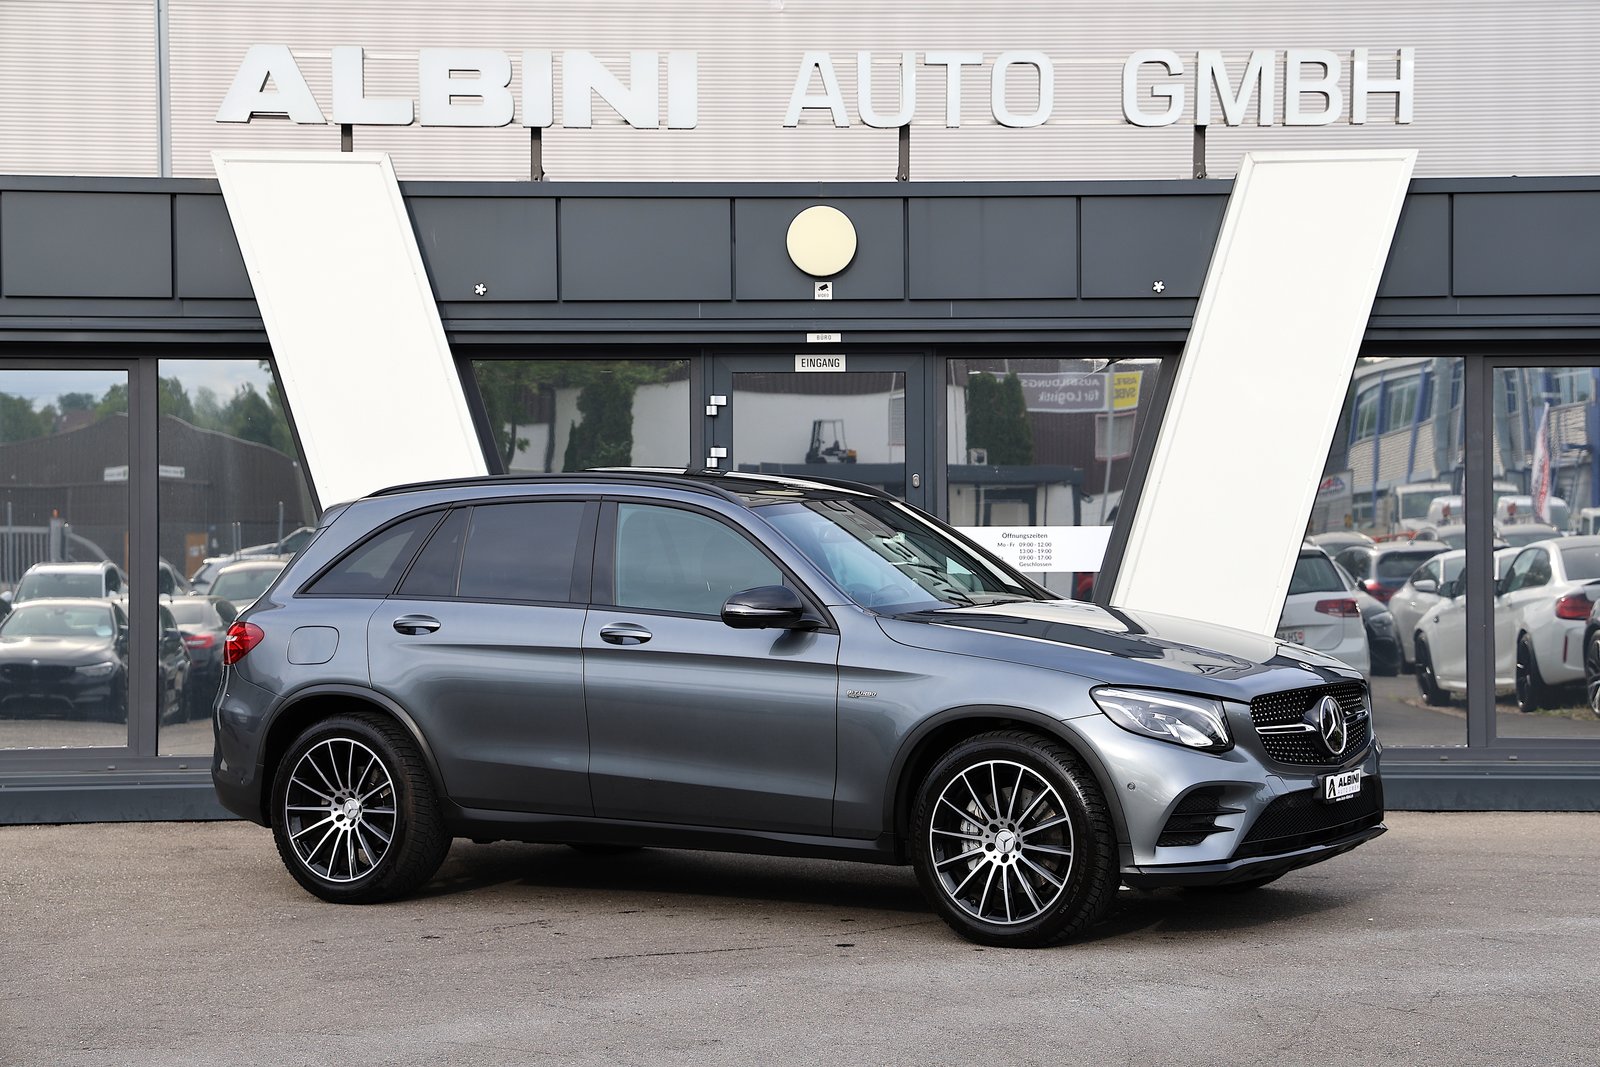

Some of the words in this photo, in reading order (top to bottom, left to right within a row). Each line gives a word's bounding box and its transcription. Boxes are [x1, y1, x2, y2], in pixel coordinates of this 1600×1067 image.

[215, 44, 698, 129] ALBINI
[783, 49, 1055, 129] AUTO
[1121, 48, 1415, 127] GMBH
[801, 358, 840, 368] EINGANG
[1338, 772, 1360, 787] ALBINI
